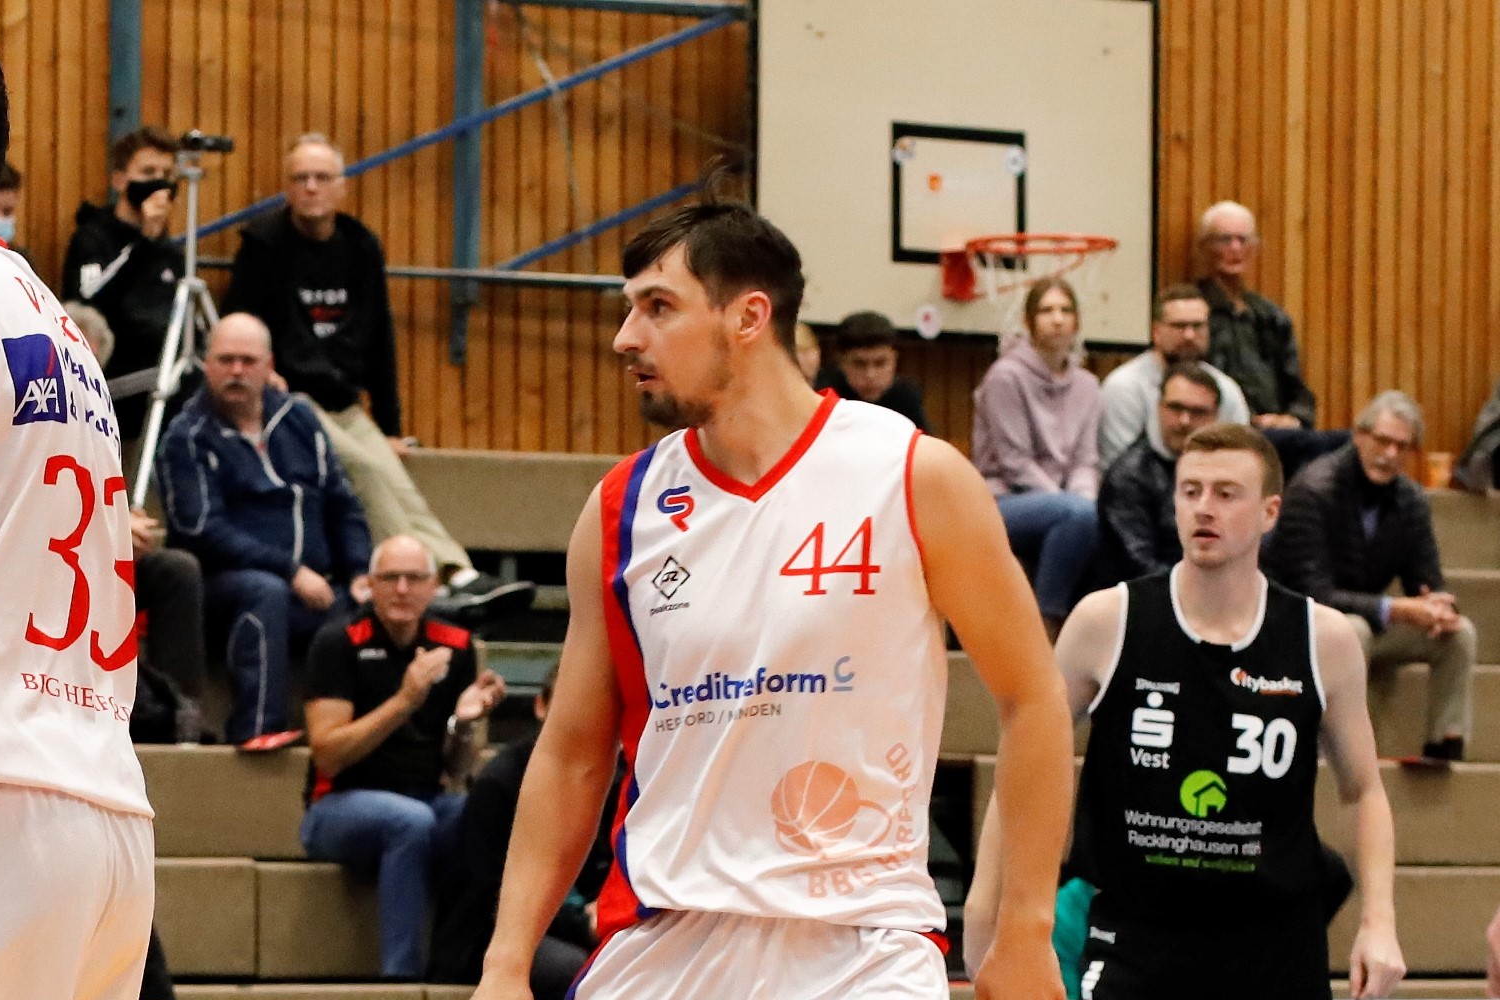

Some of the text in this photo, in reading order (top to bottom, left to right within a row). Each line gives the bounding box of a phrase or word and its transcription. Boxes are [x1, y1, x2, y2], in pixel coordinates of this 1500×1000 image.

[14, 378, 60, 416] AXA
[24, 455, 137, 671] 33
[780, 516, 881, 596] 44
[21, 673, 60, 697] BIG
[654, 667, 827, 709] Creditreform
[1130, 747, 1170, 770] Vest
[1226, 712, 1298, 780] 30
